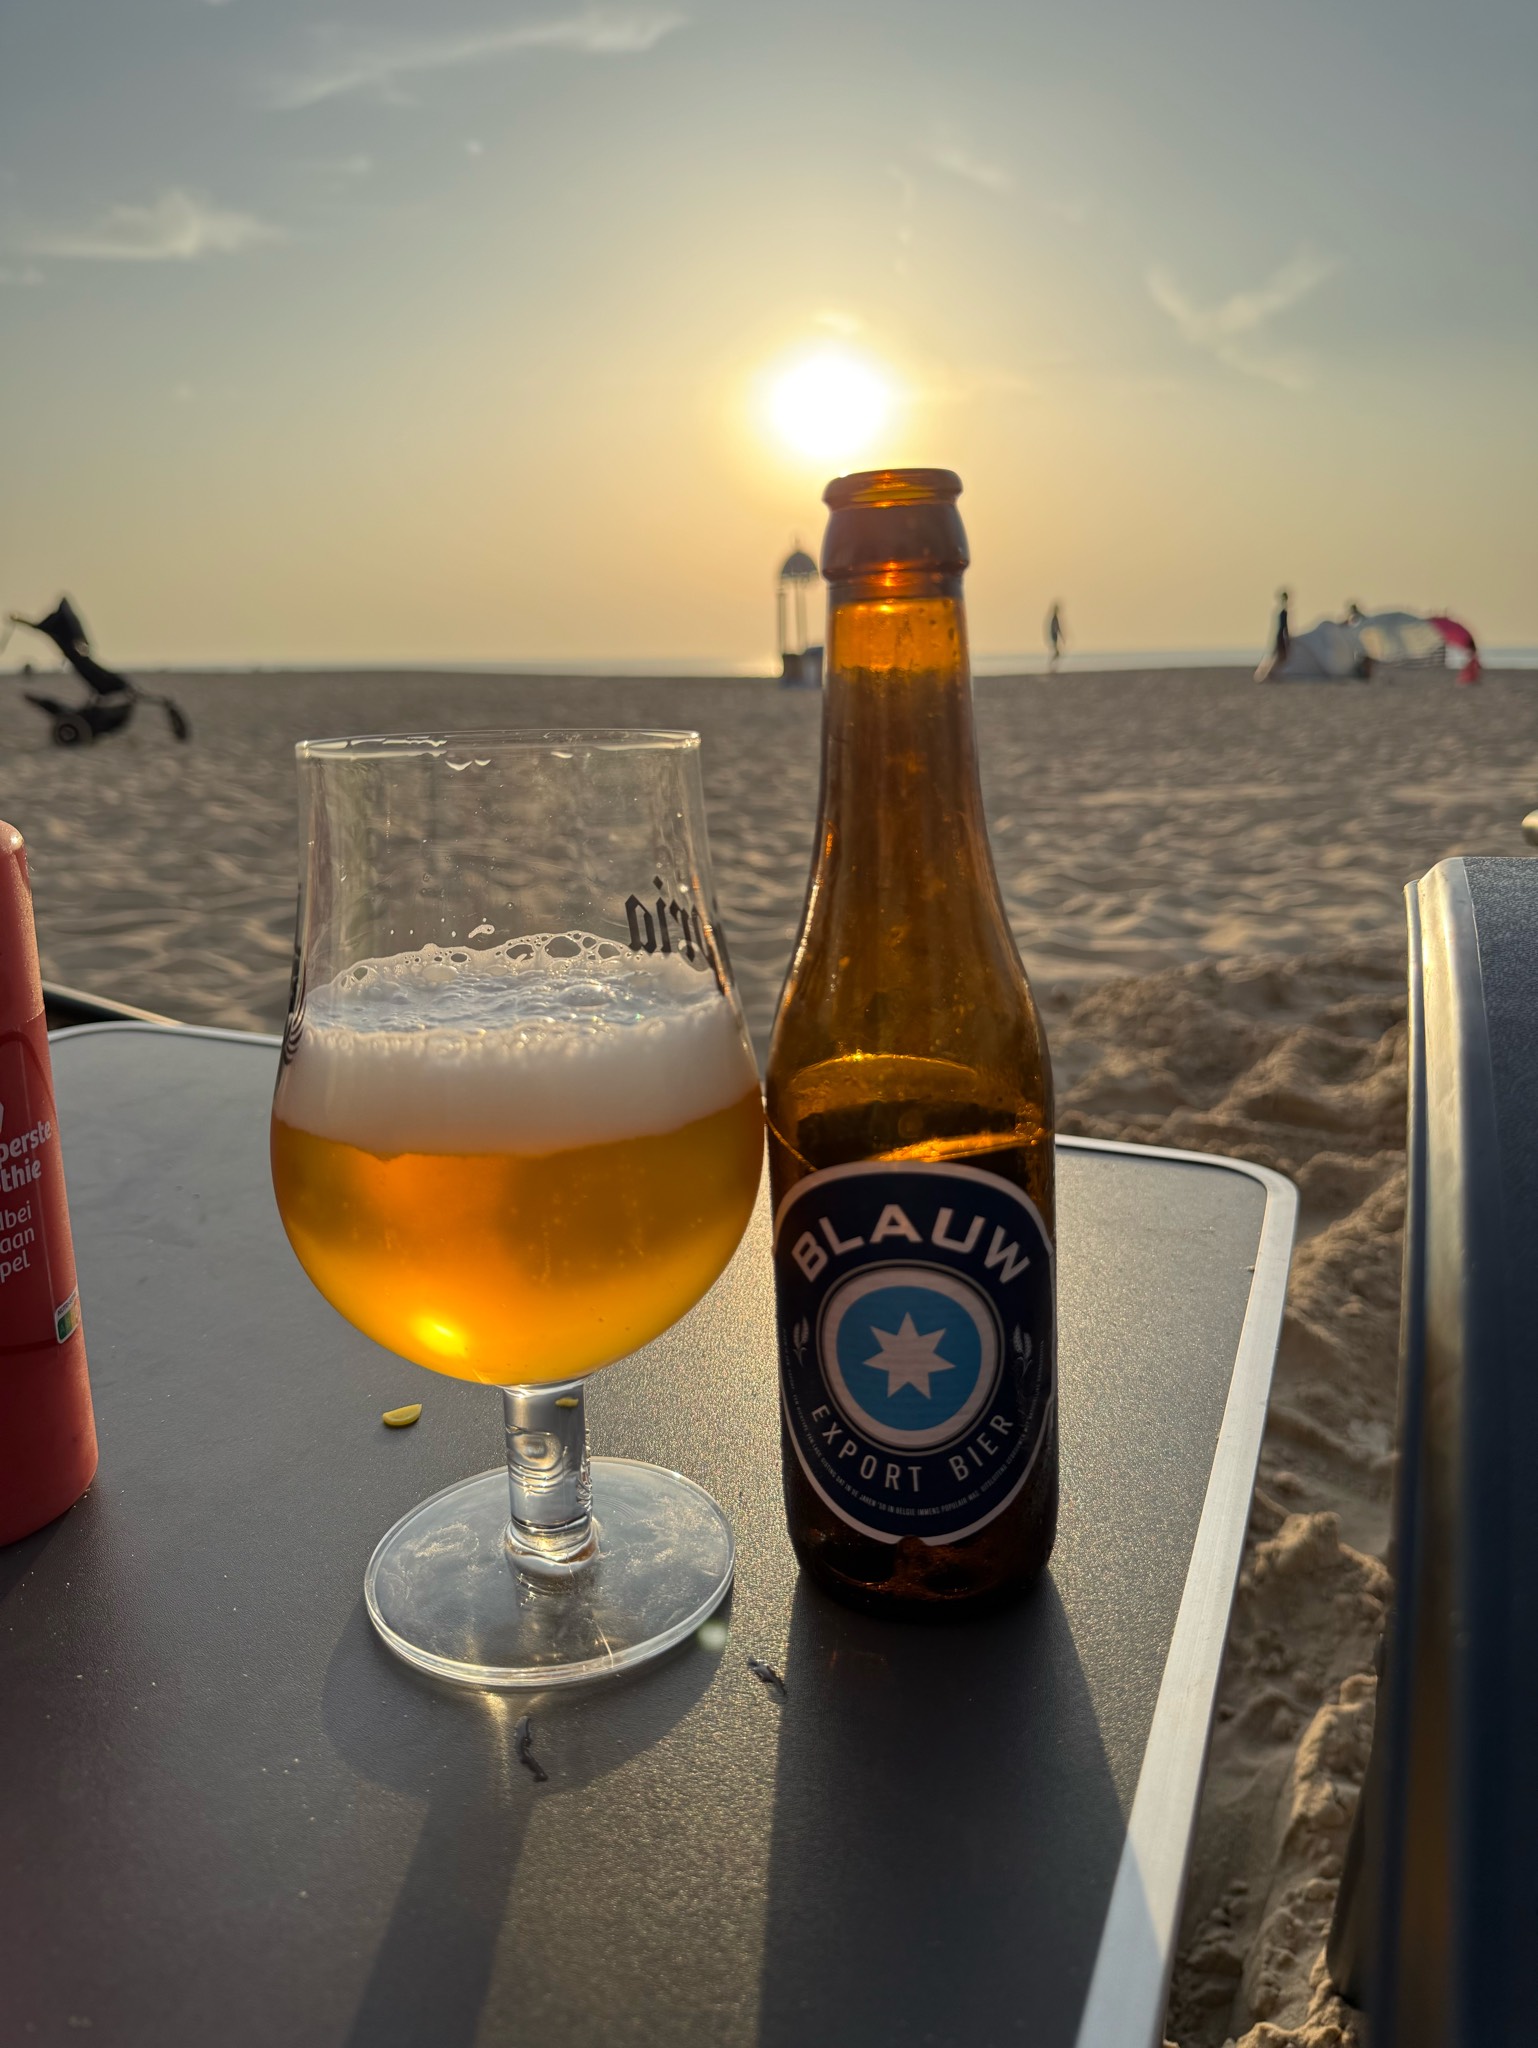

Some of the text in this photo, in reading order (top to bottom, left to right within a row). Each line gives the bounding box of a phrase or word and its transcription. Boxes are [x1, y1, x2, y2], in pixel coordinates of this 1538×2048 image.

[0, 1158, 42, 1193] thie
[0, 1200, 32, 1229] bei
[791, 1203, 1031, 1284] BLAUW
[811, 1404, 921, 1492] EXPORT
[949, 1414, 1013, 1481] BIER
[917, 1505, 941, 1516] IMMENS
[939, 1496, 968, 1513] POPULAIR
